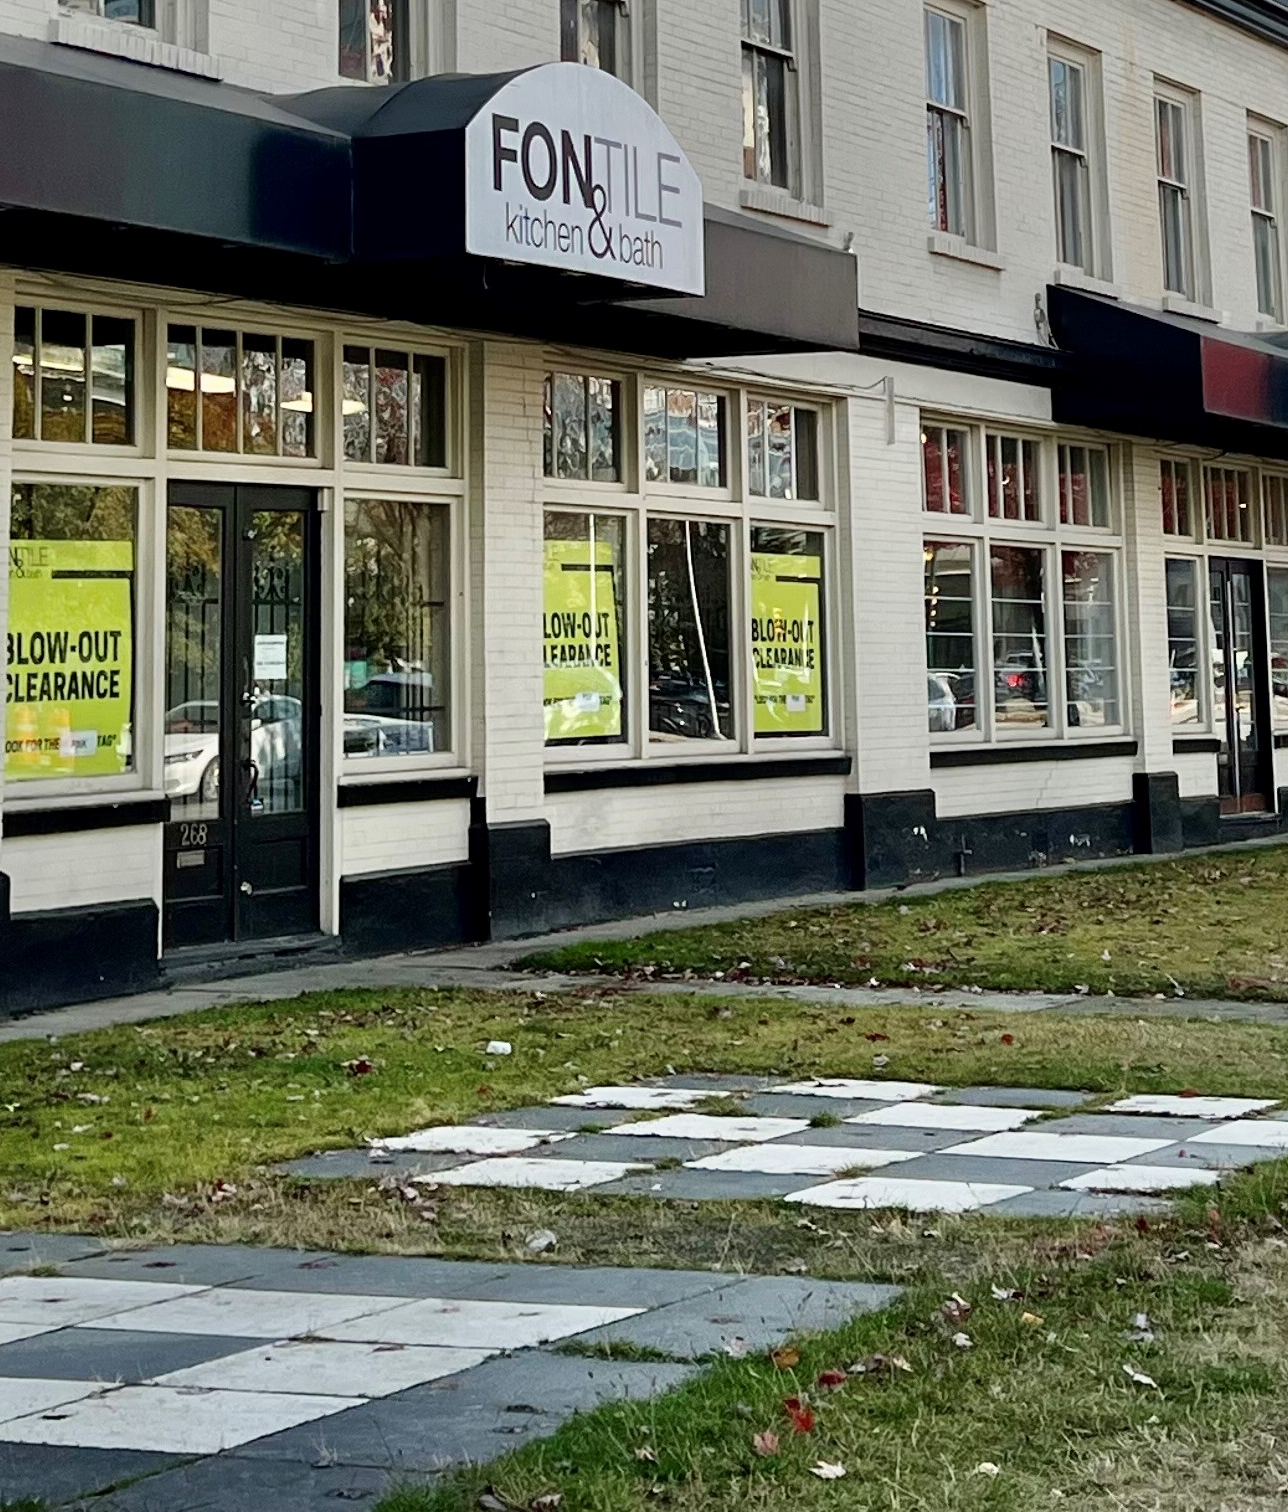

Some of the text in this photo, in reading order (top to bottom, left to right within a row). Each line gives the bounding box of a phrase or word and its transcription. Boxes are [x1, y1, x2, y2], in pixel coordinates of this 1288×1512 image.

[491, 112, 683, 229] FONTILE
[505, 183, 664, 270] kitchen & bath
[180, 823, 209, 846] 268
